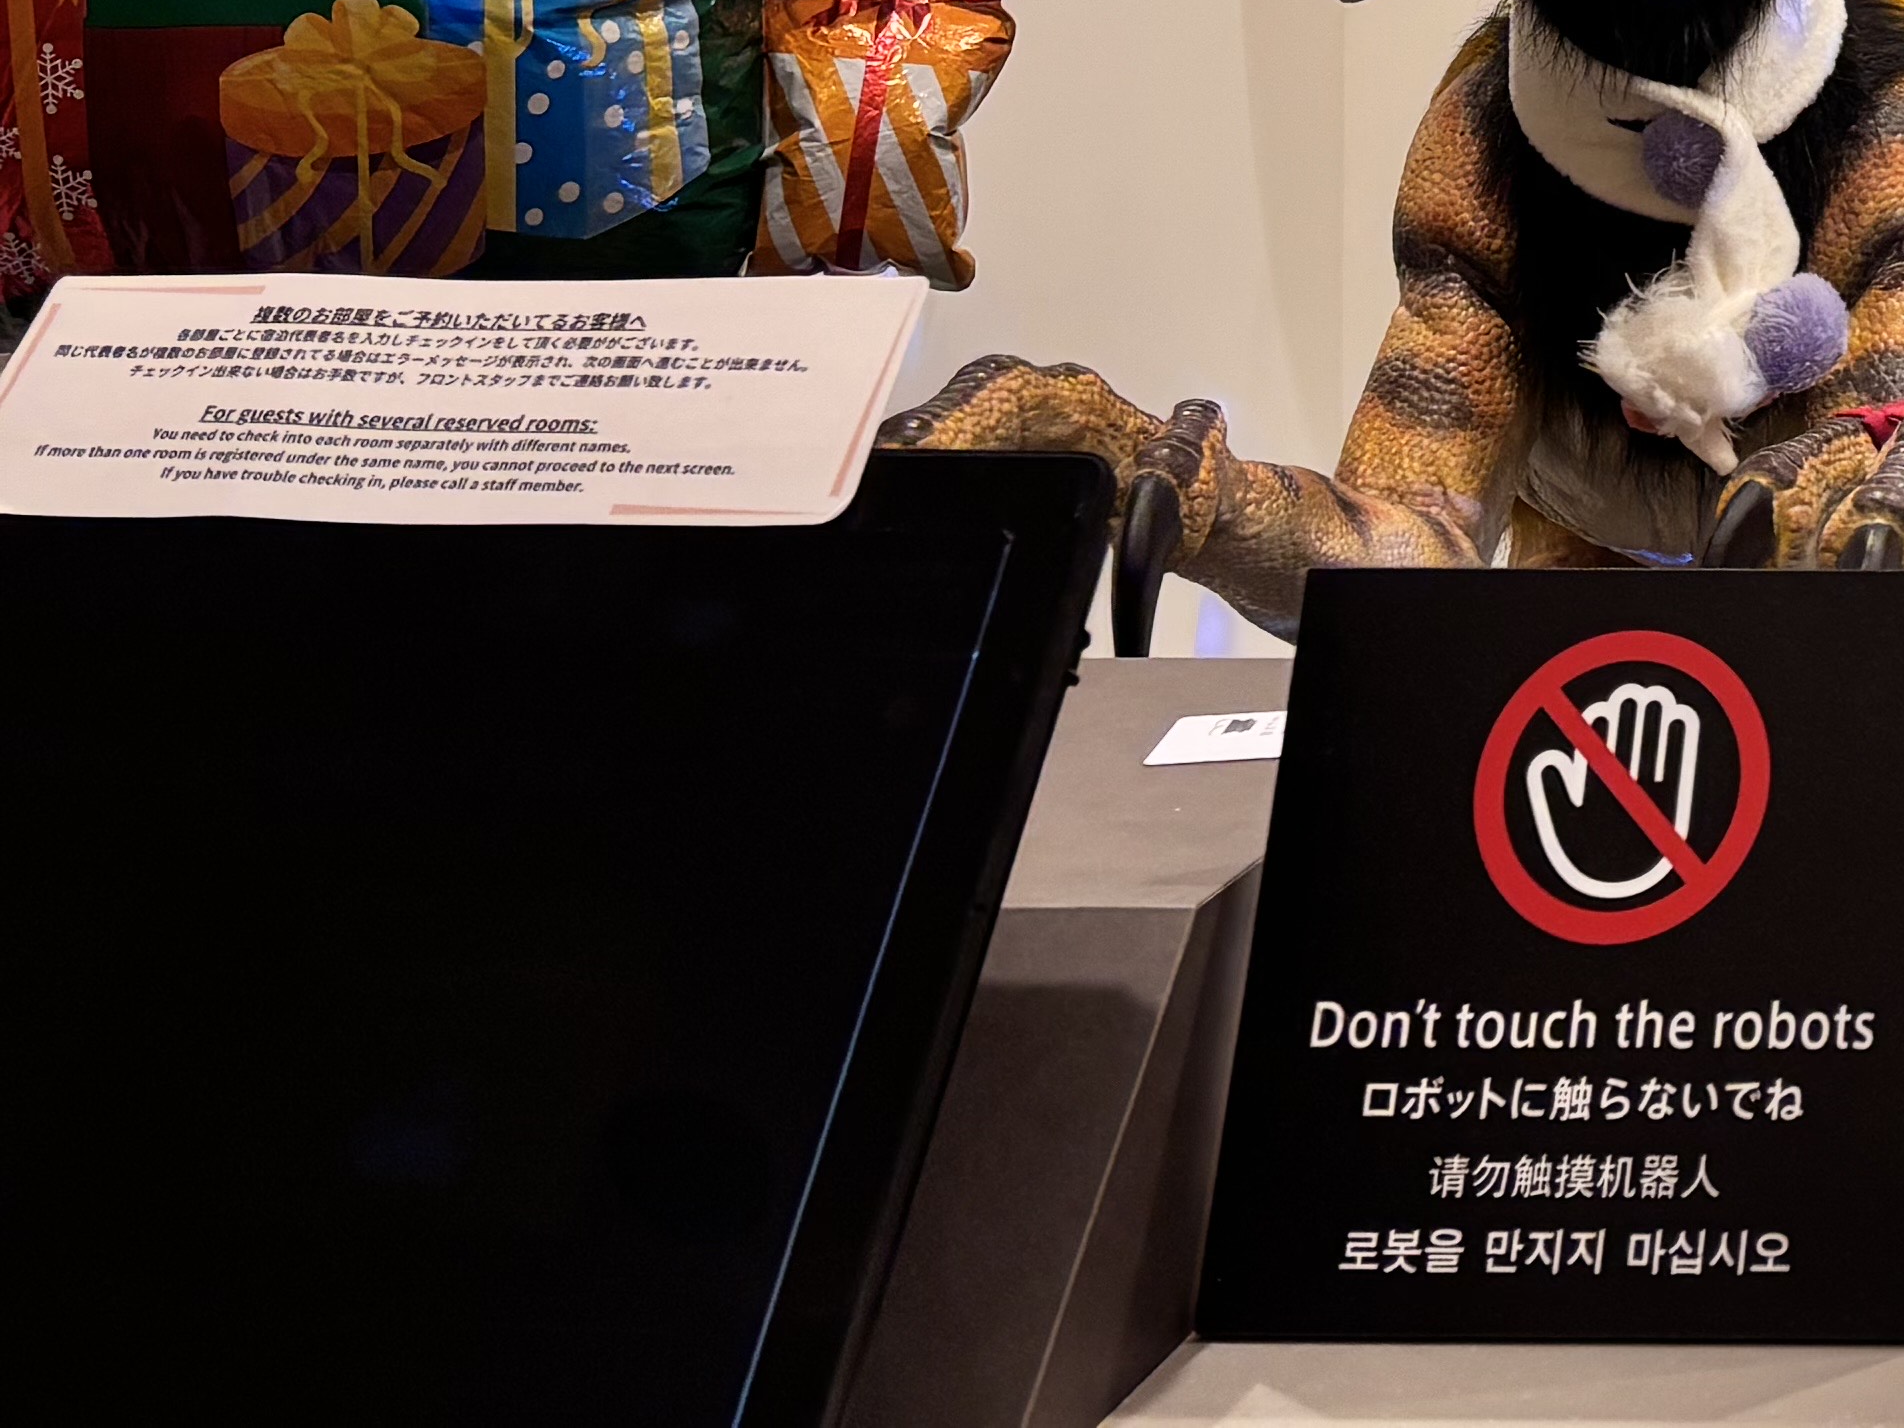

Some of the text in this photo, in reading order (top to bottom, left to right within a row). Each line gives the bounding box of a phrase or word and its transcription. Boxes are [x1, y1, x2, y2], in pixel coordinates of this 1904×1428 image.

[200, 404, 598, 435] For guests with several reserved rooms:
[33, 444, 735, 476] If more than one room is registered under the same name, you cannot proceed to the next screen.
[152, 427, 631, 454] You need to check into each room separately with different names.
[159, 466, 584, 493] If you have trouble checking in, please call a staff member.
[1309, 998, 1875, 1050] Don't touch the robots
[1362, 1075, 1804, 1121] ロボットに触らないでね
[1428, 1153, 1720, 1199] 请勿触摸机器人
[1338, 1228, 1791, 1276] 로봇을 만지지 마십시오
